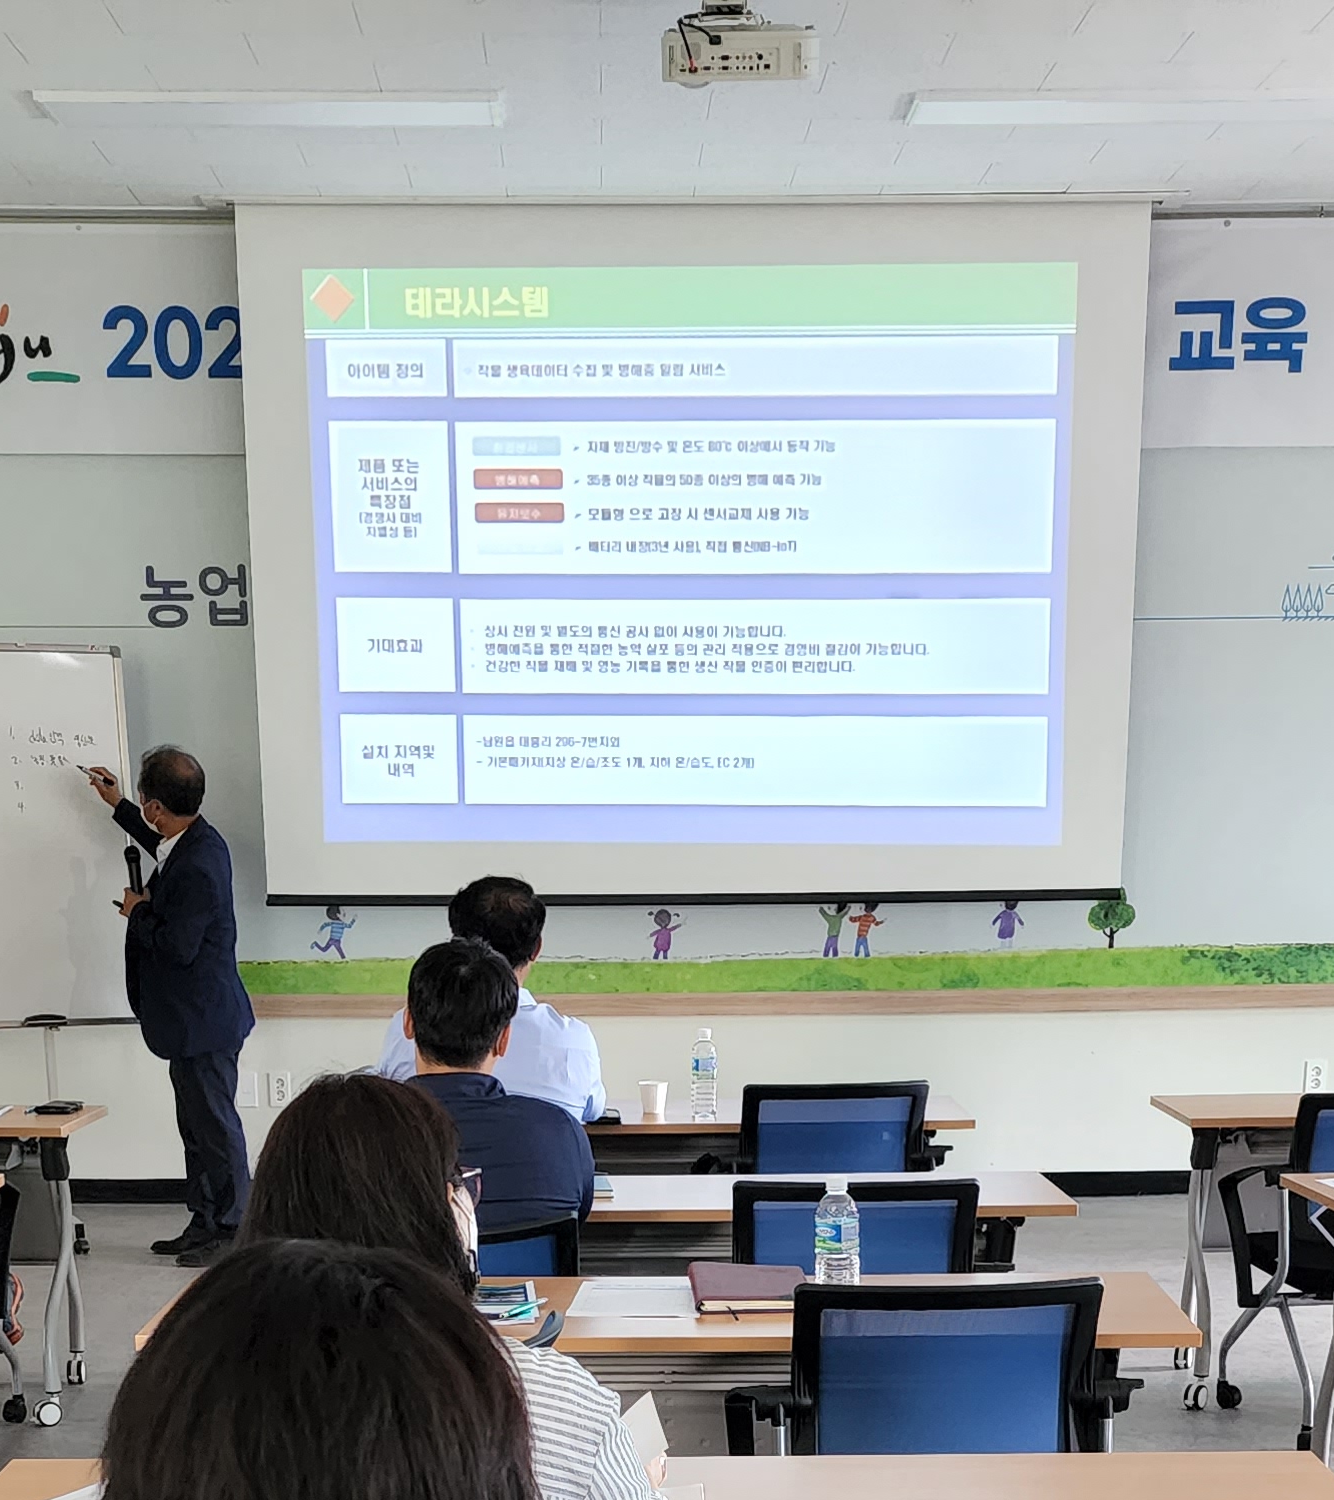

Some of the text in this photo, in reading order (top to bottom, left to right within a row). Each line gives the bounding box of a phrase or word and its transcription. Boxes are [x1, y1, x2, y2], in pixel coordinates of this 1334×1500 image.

[403, 286, 550, 319] 테라시스템
[102, 305, 242, 379] 202
[1168, 297, 1308, 373] 교육
[346, 362, 424, 380] 아이템 정의
[506, 362, 569, 379] 생육데이터
[572, 362, 598, 379] 수집
[601, 362, 614, 379] 및
[688, 362, 726, 379] 서비스
[357, 457, 420, 475] 제품 또는
[360, 476, 418, 493] 서비스의
[615, 473, 639, 488] 이상
[707, 473, 742, 488] 이상의
[369, 494, 412, 510] 특장점
[628, 506, 654, 522] 으로
[657, 506, 682, 522] 고장
[139, 563, 249, 629] 농업
[540, 624, 552, 639] 및
[556, 624, 593, 639] 별도의
[597, 624, 621, 639] 통신
[653, 624, 678, 639] 없이
[681, 624, 718, 639] 사용이
[366, 638, 424, 654] 기대효과
[549, 642, 574, 657] 통한
[617, 642, 642, 657] 농약
[702, 642, 726, 657] 관리
[485, 659, 521, 674] 건강한
[581, 659, 593, 674] 및
[666, 659, 690, 674] 통한
[791, 659, 856, 674] 편리합니다.
[361, 744, 435, 760] 설치 지역및
[387, 762, 416, 778] 내역
